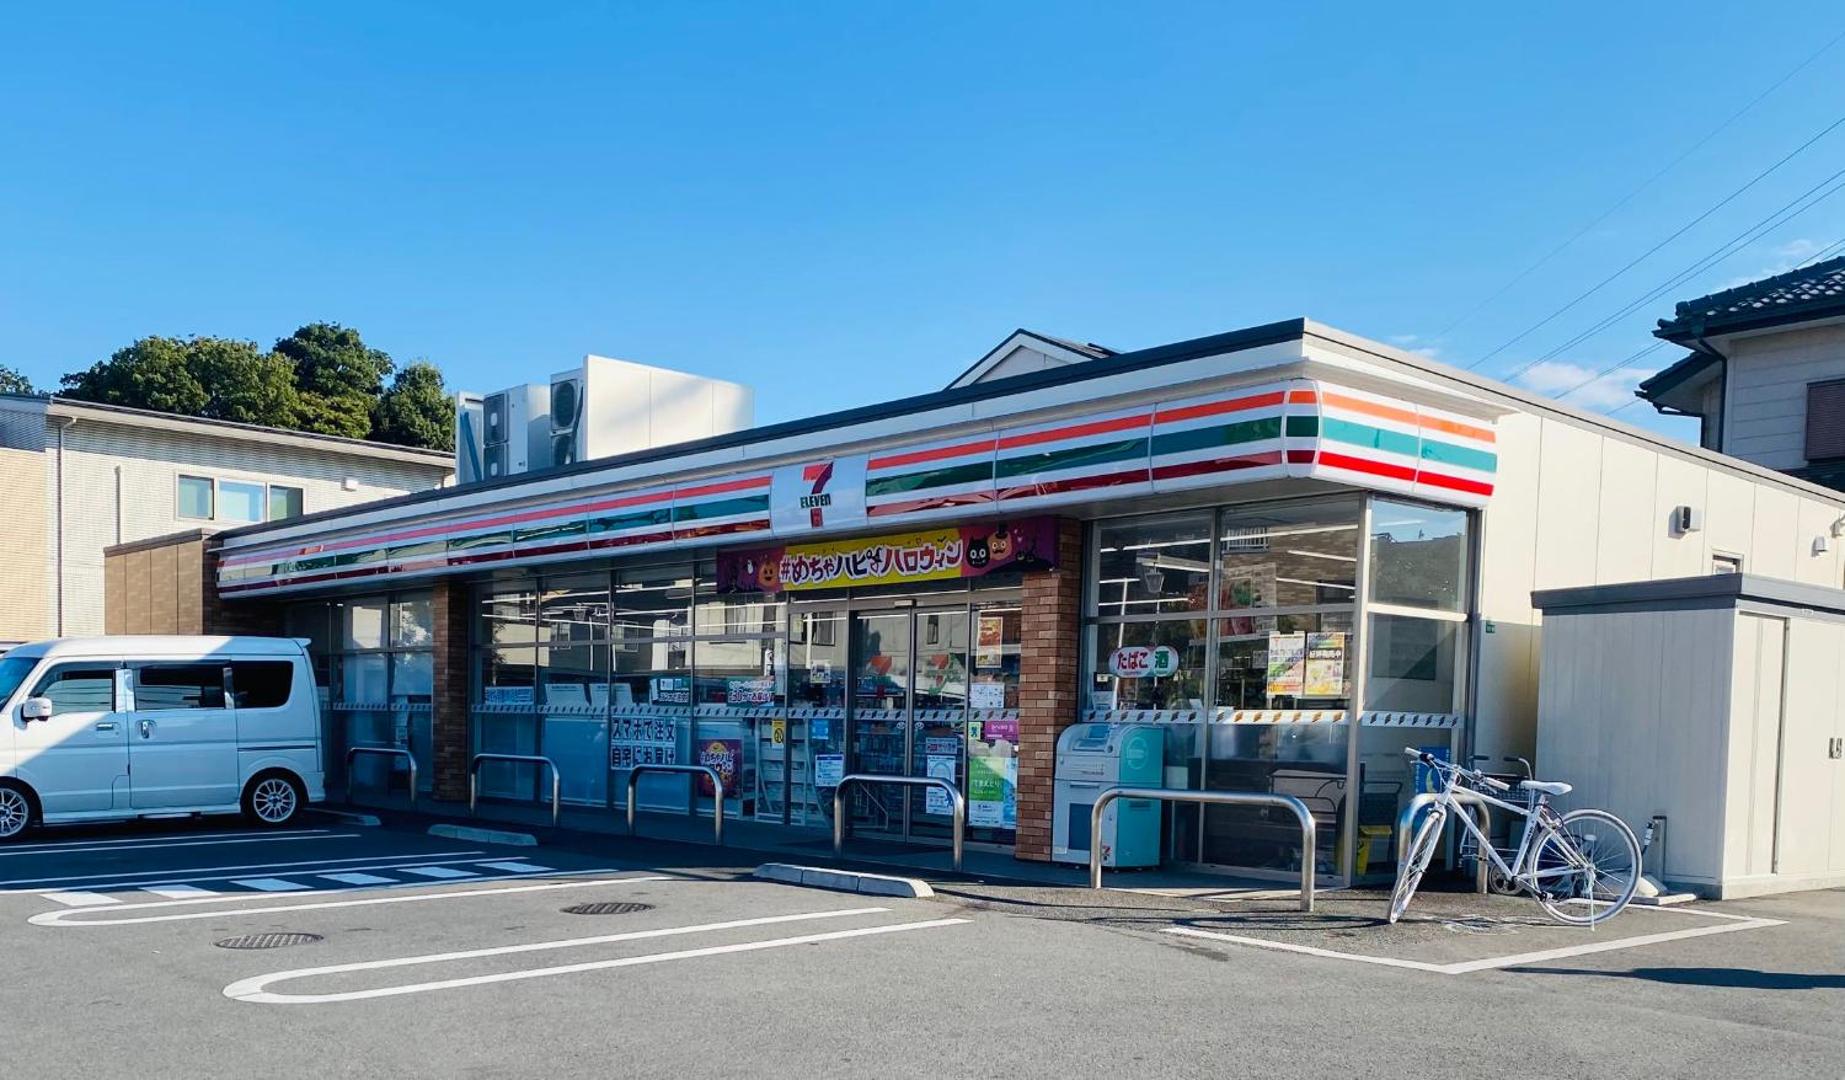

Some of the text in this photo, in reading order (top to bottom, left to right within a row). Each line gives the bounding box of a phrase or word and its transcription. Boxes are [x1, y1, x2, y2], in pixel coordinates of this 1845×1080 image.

[803, 461, 834, 528] 7
[1117, 651, 1148, 669] たばこ
[1155, 650, 1169, 668] 酒
[613, 719, 675, 740] スマホで注文
[613, 746, 675, 767] 自宅にお届け
